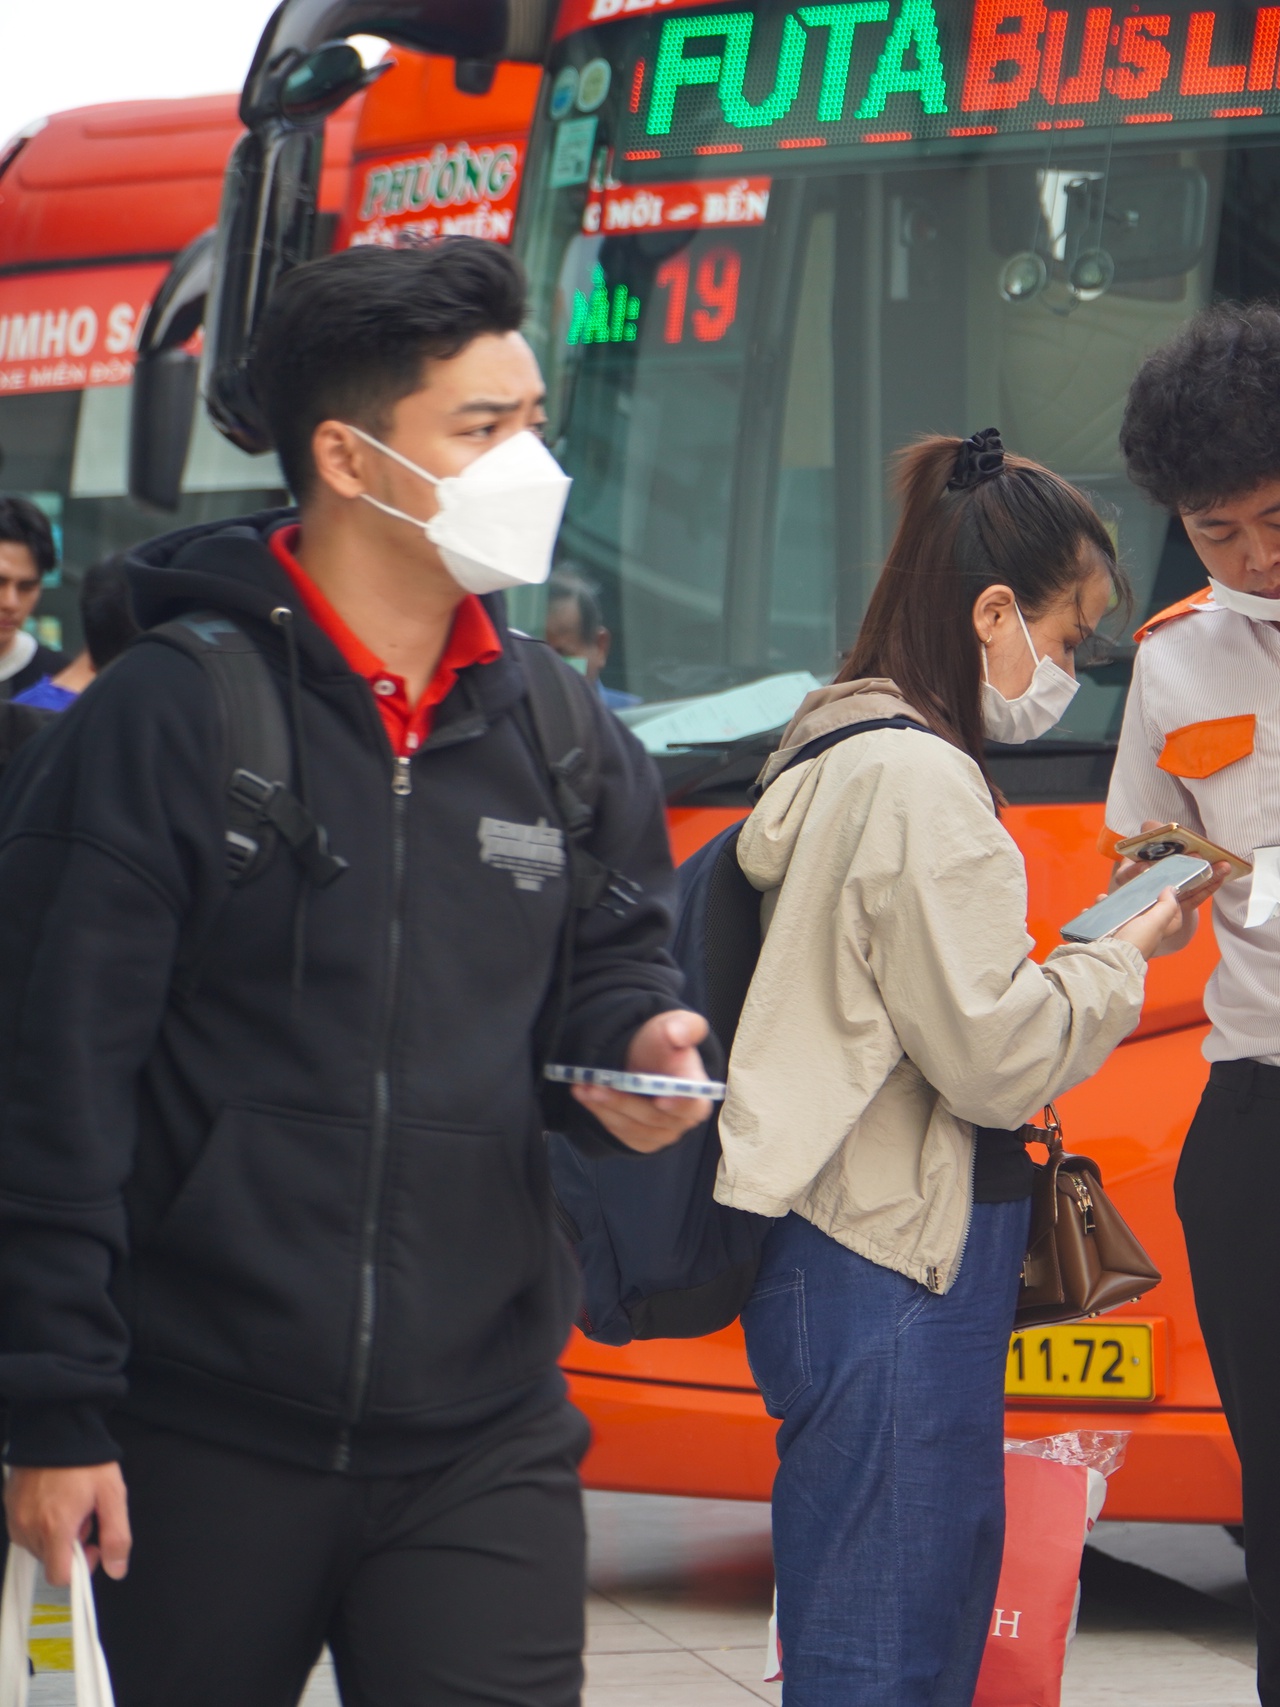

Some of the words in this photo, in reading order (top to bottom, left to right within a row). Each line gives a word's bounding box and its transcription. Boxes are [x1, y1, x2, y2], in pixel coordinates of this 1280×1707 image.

[646, 0, 948, 135] FUTA
[655, 248, 742, 343] 19
[991, 1608, 1022, 1639] H
